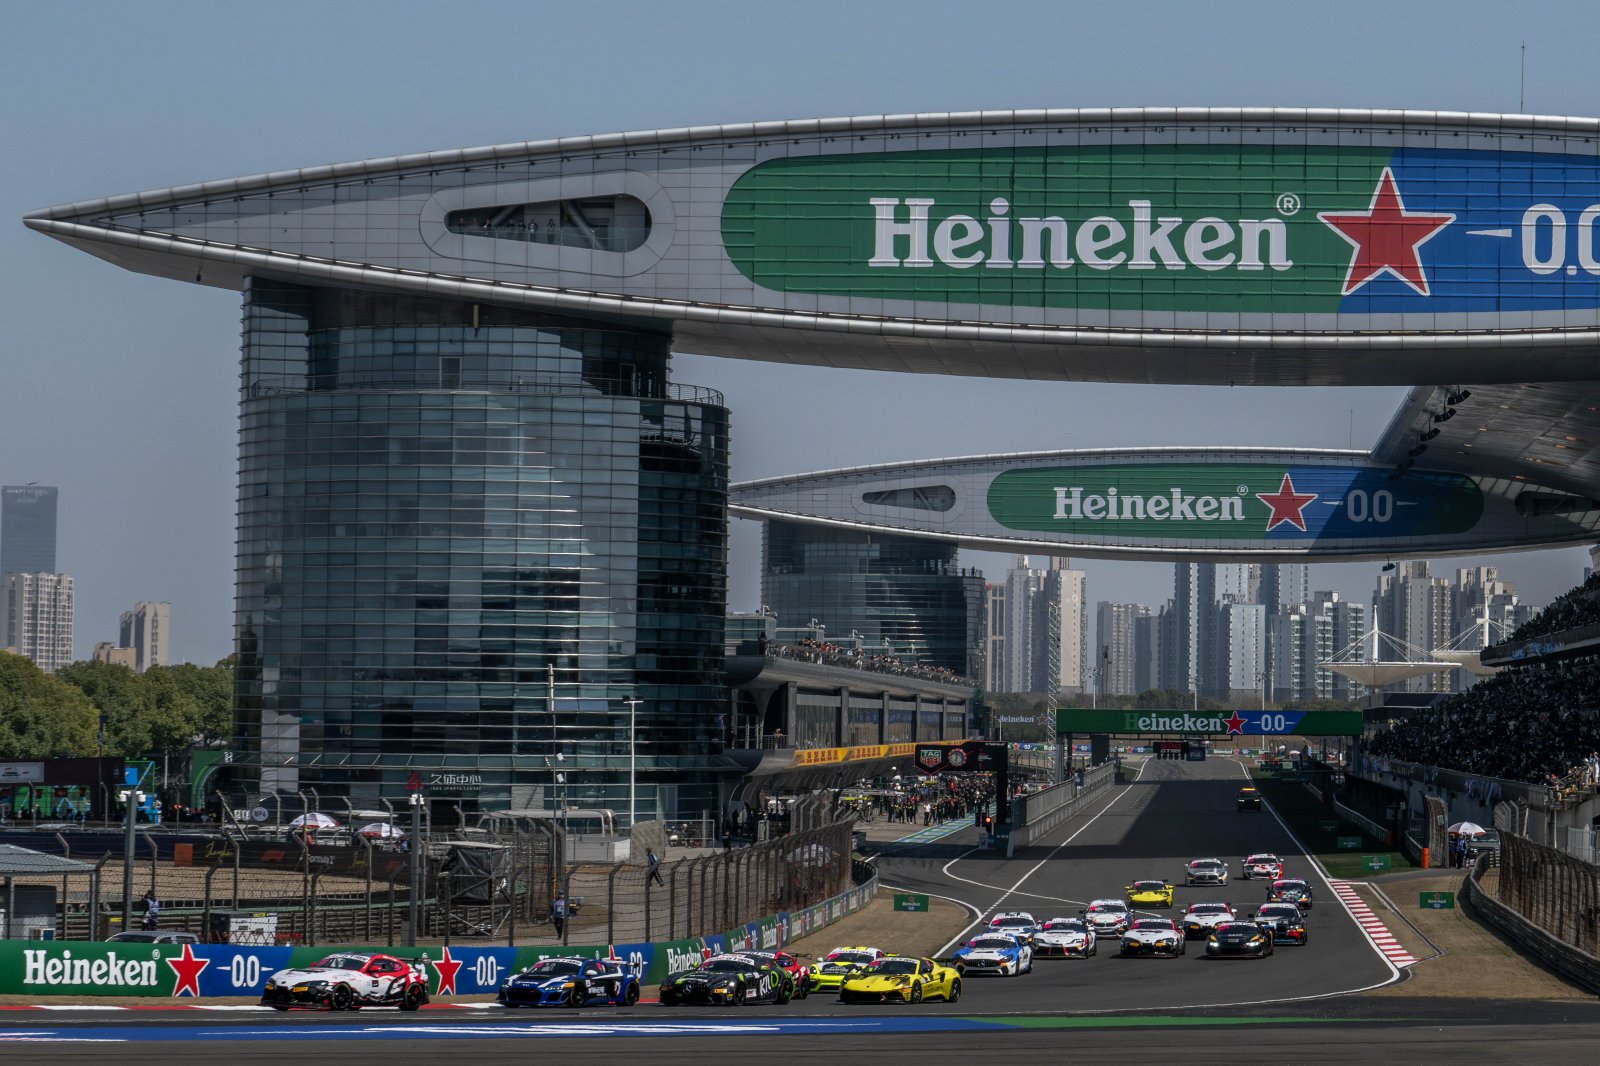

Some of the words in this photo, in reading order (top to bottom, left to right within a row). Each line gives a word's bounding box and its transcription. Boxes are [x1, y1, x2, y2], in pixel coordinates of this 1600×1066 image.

[867, 196, 1294, 271] Heineken
[1053, 486, 1245, 521] Heineken
[1347, 489, 1392, 523] 0.0
[1124, 713, 1223, 732] Heineken
[1261, 714, 1285, 732] 0.0
[23, 949, 158, 986] Heineken
[231, 955, 260, 987] 0.0
[476, 955, 497, 986] 0.0
